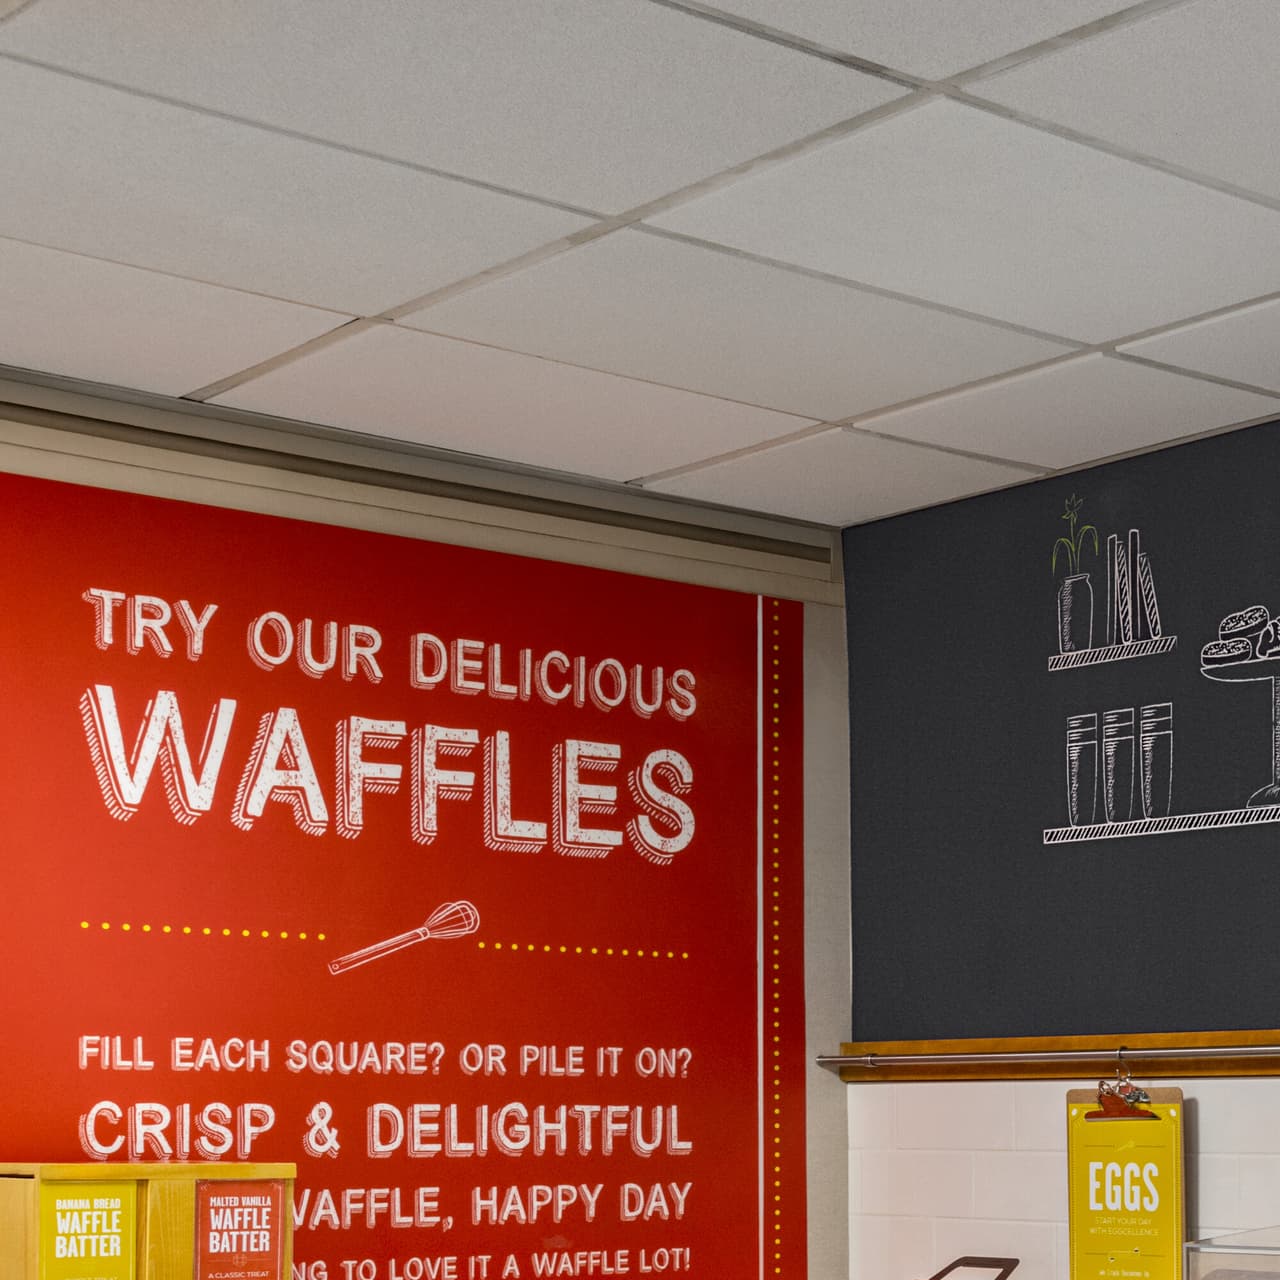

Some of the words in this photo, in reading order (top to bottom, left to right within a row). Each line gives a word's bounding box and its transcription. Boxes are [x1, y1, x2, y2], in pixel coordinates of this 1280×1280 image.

[82, 587, 218, 661] TRY
[247, 611, 383, 684] OUR
[409, 632, 697, 721] DELICIOUS
[80, 685, 695, 865] WAFFLES
[79, 1036, 154, 1071] FILL
[171, 1037, 269, 1072] EACH
[286, 1040, 445, 1075] SQUARE?
[459, 1043, 507, 1076] OR
[520, 1045, 584, 1077] PILE
[596, 1047, 623, 1077] IT
[635, 1047, 692, 1078] ON?
[79, 1100, 275, 1160] CRISP
[303, 1101, 341, 1159] &
[367, 1101, 693, 1159] DELIGHTFUL
[1089, 1161, 1160, 1212] EGGS
[56, 1199, 90, 1210] BANANA
[93, 1198, 121, 1209] BREAD
[210, 1196, 239, 1207] MALTED
[242, 1196, 271, 1206] VANILLA
[472, 1183, 603, 1225] HAPPY
[620, 1182, 692, 1221] DAY
[56, 1211, 122, 1233] WAFFLE
[210, 1208, 271, 1230] WAFFLE
[55, 1235, 121, 1258] BATTER
[209, 1230, 270, 1253] BATTER
[215, 1271, 246, 1279] CLASSIC
[469, 1255, 492, 1280] IT
[502, 1254, 520, 1279] A
[531, 1250, 630, 1277] WAFFLE
[639, 1247, 691, 1273] LOT!
